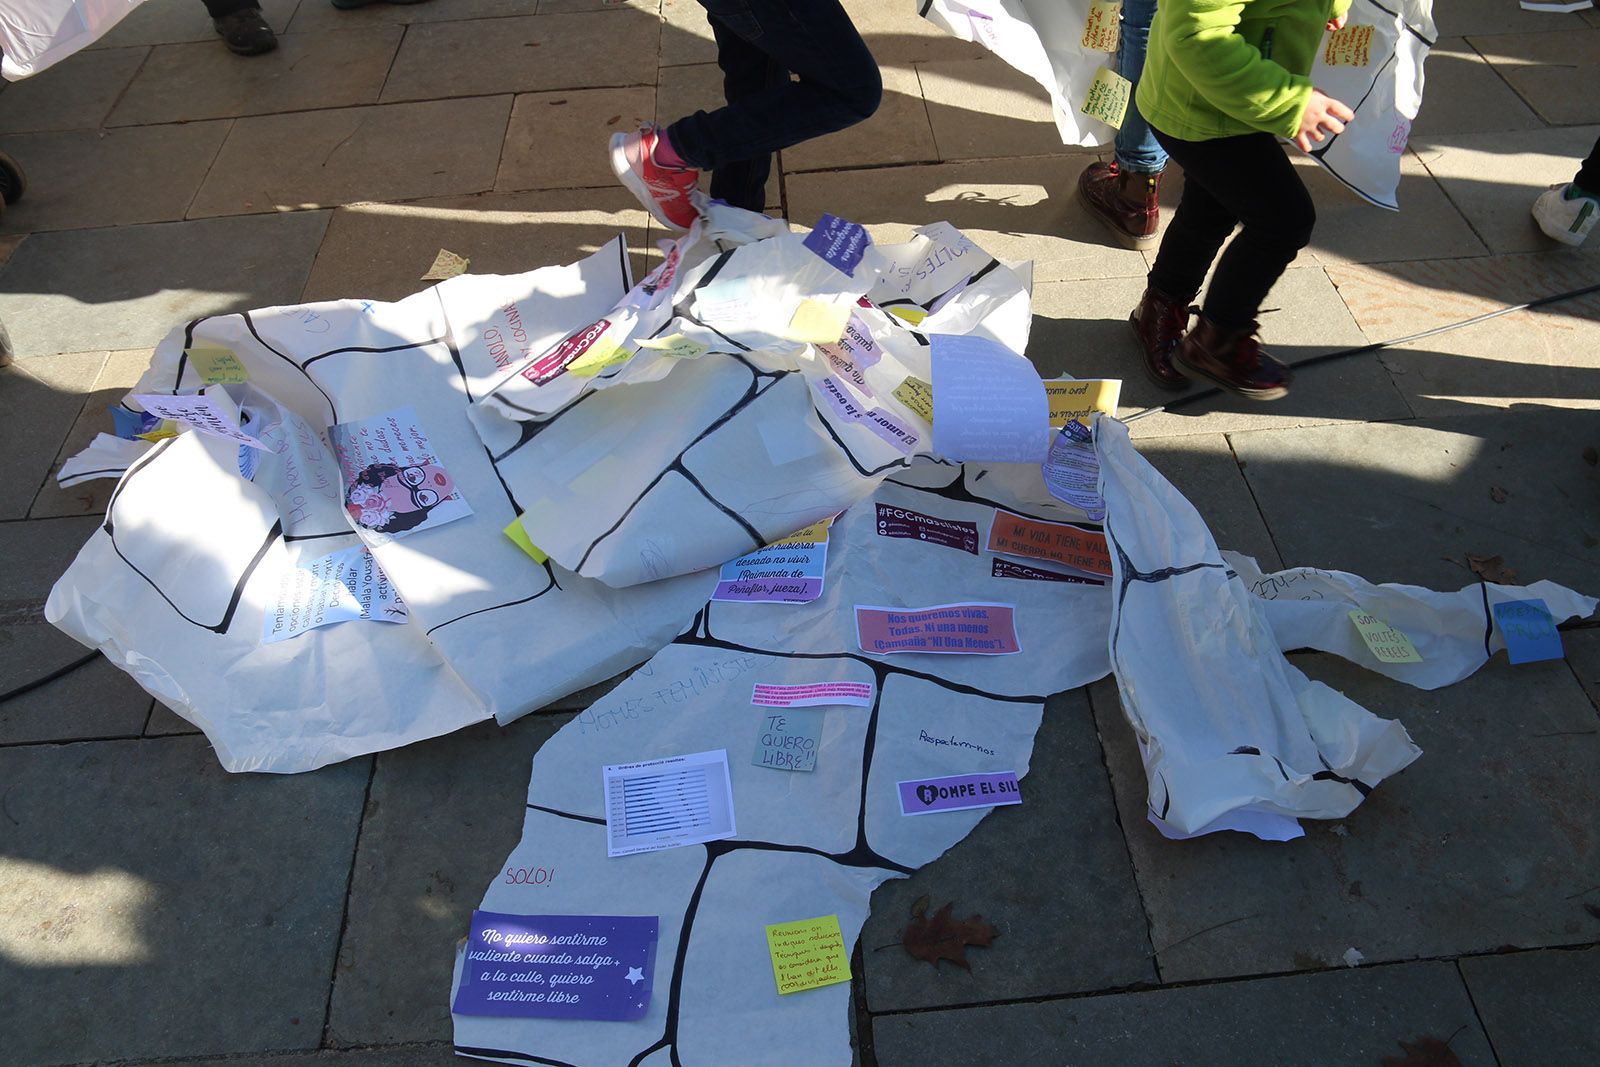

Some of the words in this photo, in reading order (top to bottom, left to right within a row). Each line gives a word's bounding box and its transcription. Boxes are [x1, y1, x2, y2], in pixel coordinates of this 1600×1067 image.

[826, 223, 852, 259] onquista
[876, 417, 906, 438] amor
[1013, 526, 1025, 537] MI
[1031, 530, 1051, 543] VIDA
[1056, 534, 1081, 549] TIENE
[736, 557, 772, 566] deseado
[786, 555, 810, 564] vivir
[887, 613, 906, 624] Nos
[908, 609, 960, 622] queremos
[962, 608, 989, 619] vivas.
[889, 626, 922, 637] Todas.
[925, 623, 935, 633] Ni
[937, 624, 956, 633] una
[958, 623, 989, 633] menos
[767, 715, 786, 732] TE
[762, 736, 814, 750] QUIERO
[981, 782, 996, 794] EL
[505, 868, 555, 887] SOLO!
[482, 929, 502, 944] No
[504, 932, 548, 946] quiero
[549, 934, 607, 946] sentirme
[468, 951, 521, 963] valiente
[524, 955, 573, 965] cuando
[574, 953, 613, 969] salga
[481, 972, 491, 981] a
[492, 970, 507, 981] la
[510, 971, 545, 984] calle,
[549, 973, 594, 987] quiero
[487, 991, 545, 1002] sentirme
[547, 991, 580, 1003] libre
